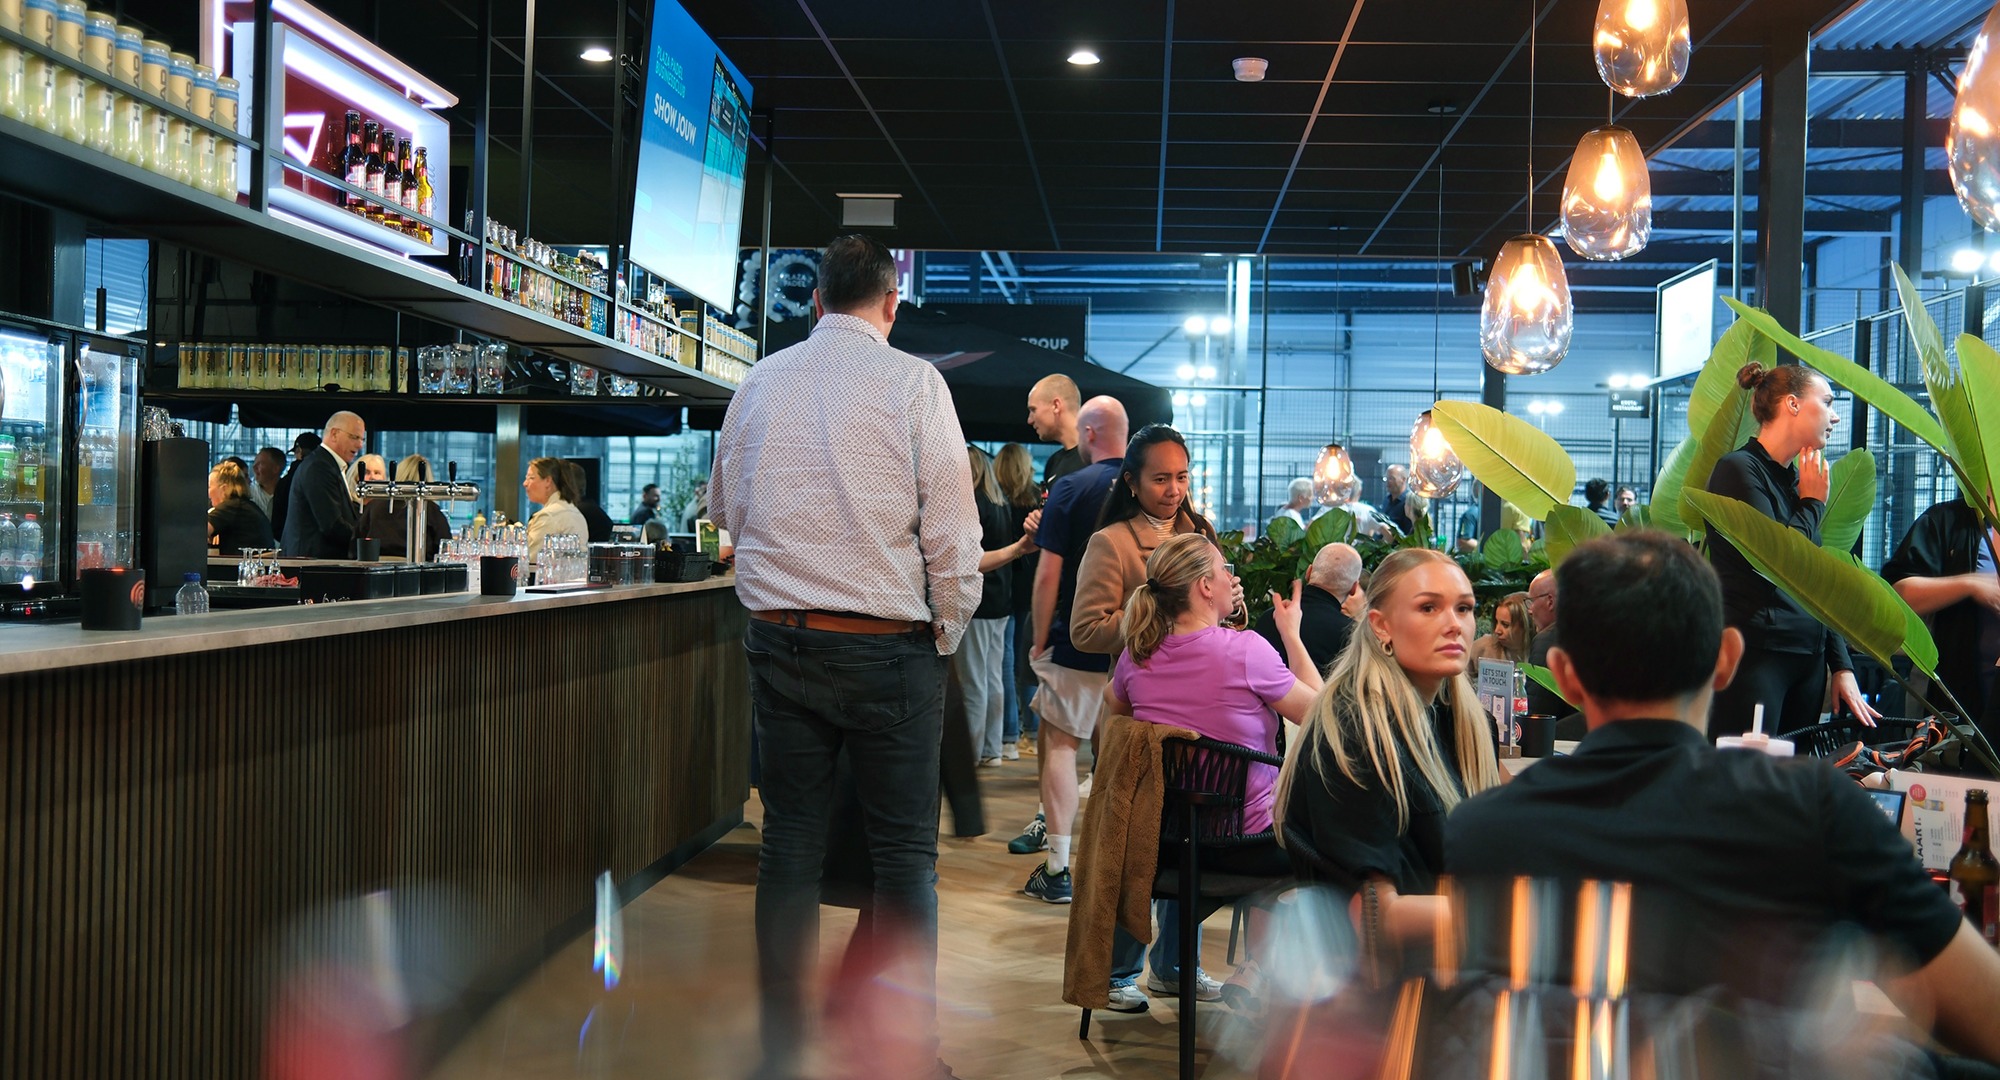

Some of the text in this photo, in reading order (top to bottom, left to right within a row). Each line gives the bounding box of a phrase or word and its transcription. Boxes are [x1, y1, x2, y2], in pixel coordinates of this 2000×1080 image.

[45, 14, 53, 87] HAD
[653, 92, 678, 130] SHOW
[675, 113, 697, 146] JOUW
[1021, 337, 1069, 350] ROUP
[1482, 668, 1508, 678] LET'S STAY
[1488, 678, 1507, 686] TOUCH
